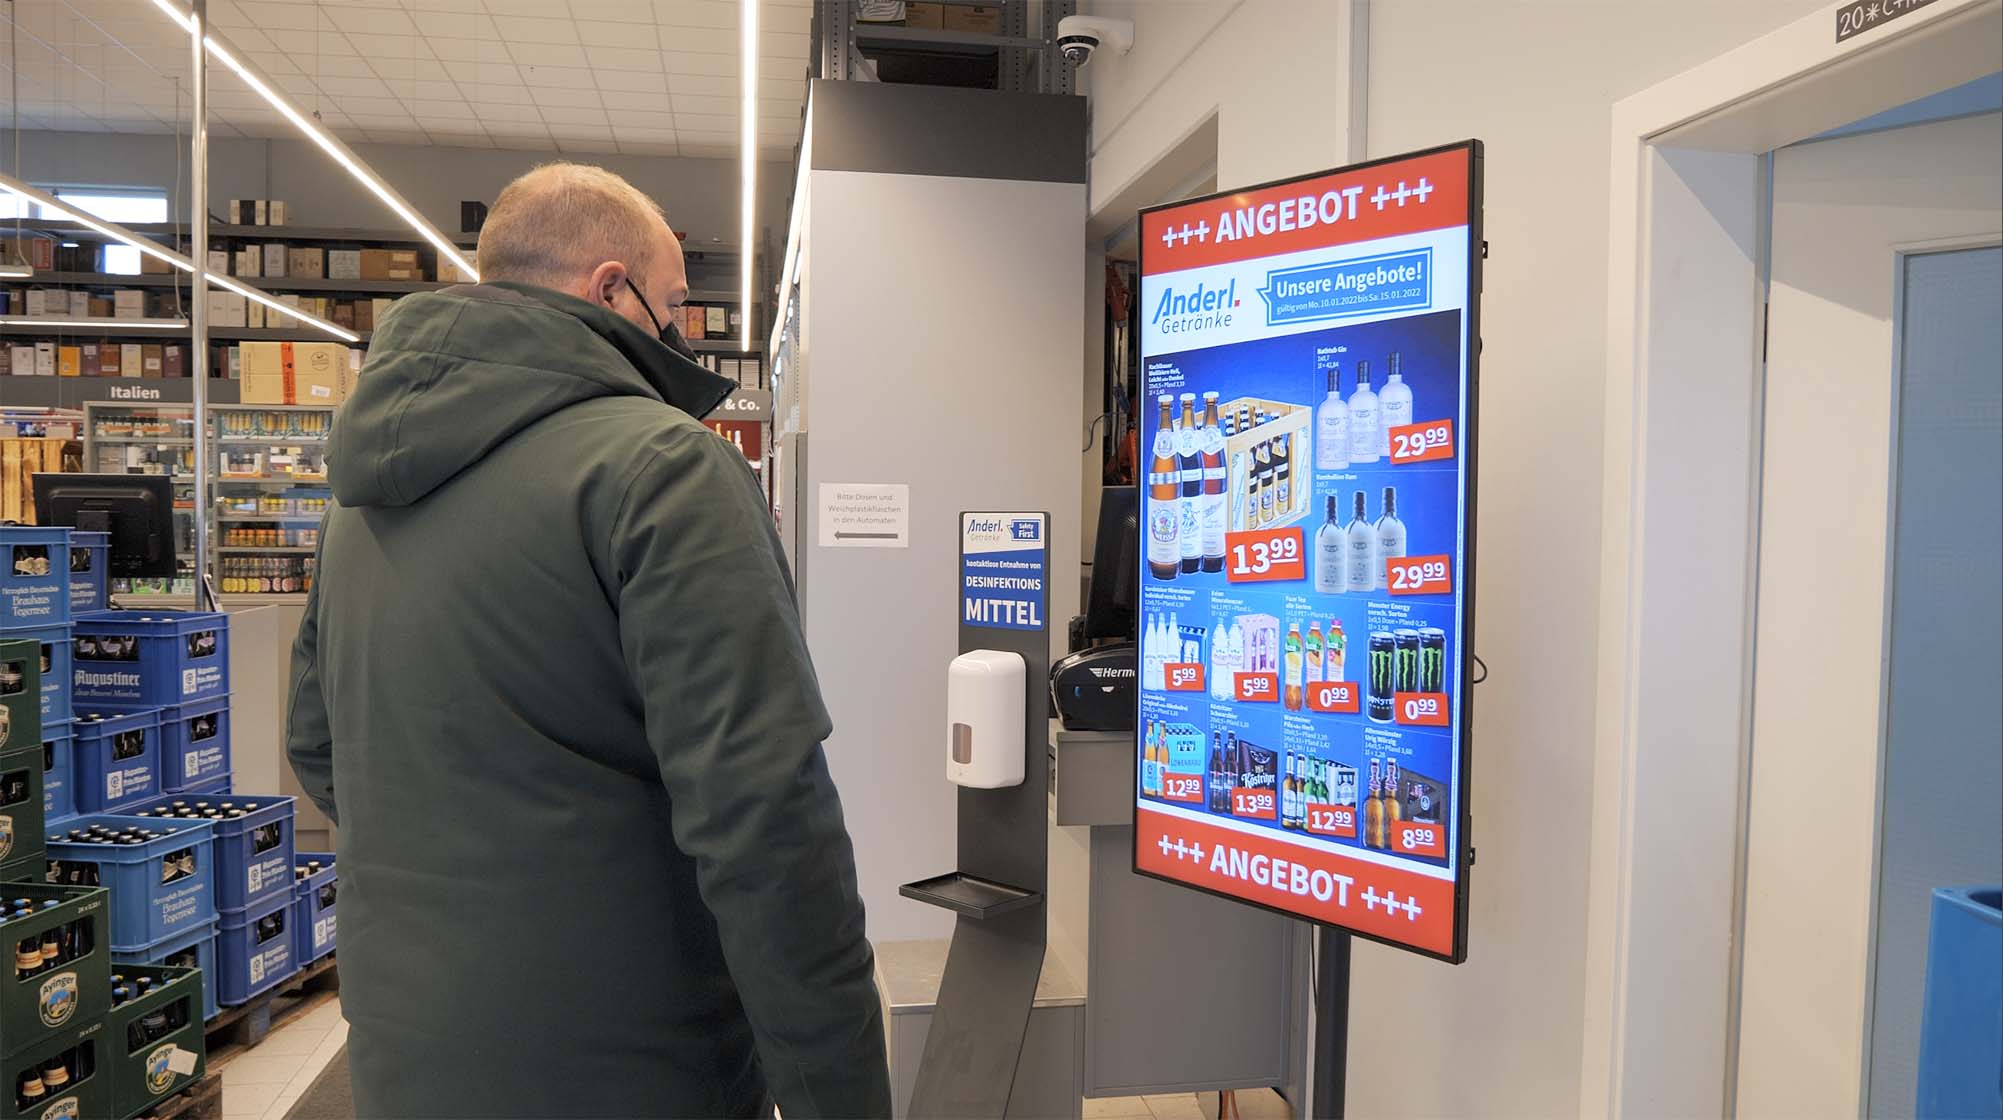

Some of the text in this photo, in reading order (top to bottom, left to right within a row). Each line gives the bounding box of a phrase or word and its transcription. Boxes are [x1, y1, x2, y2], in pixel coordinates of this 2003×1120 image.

[1215, 186, 1364, 244] ANGEBOT
[1277, 264, 1423, 298] Unsere Angebote!
[1152, 278, 1241, 324] Anderl.
[1321, 296, 1357, 310] 10.01.2022
[1381, 287, 1420, 301] 15.01.2022
[1161, 311, 1232, 334] Getränke
[111, 386, 160, 399] Italien
[724, 398, 760, 410] & Co.
[837, 493, 853, 501] Bitte
[879, 493, 893, 501] und
[1018, 530, 1034, 538] First
[1000, 560, 1029, 569] Entnahme
[966, 575, 1041, 590] DESINFEKTIONS
[966, 598, 1041, 626] MITTEL
[74, 669, 140, 687] Augustiner
[1210, 844, 1354, 907] ANGEBOT
[43, 976, 75, 993] Ayinger
